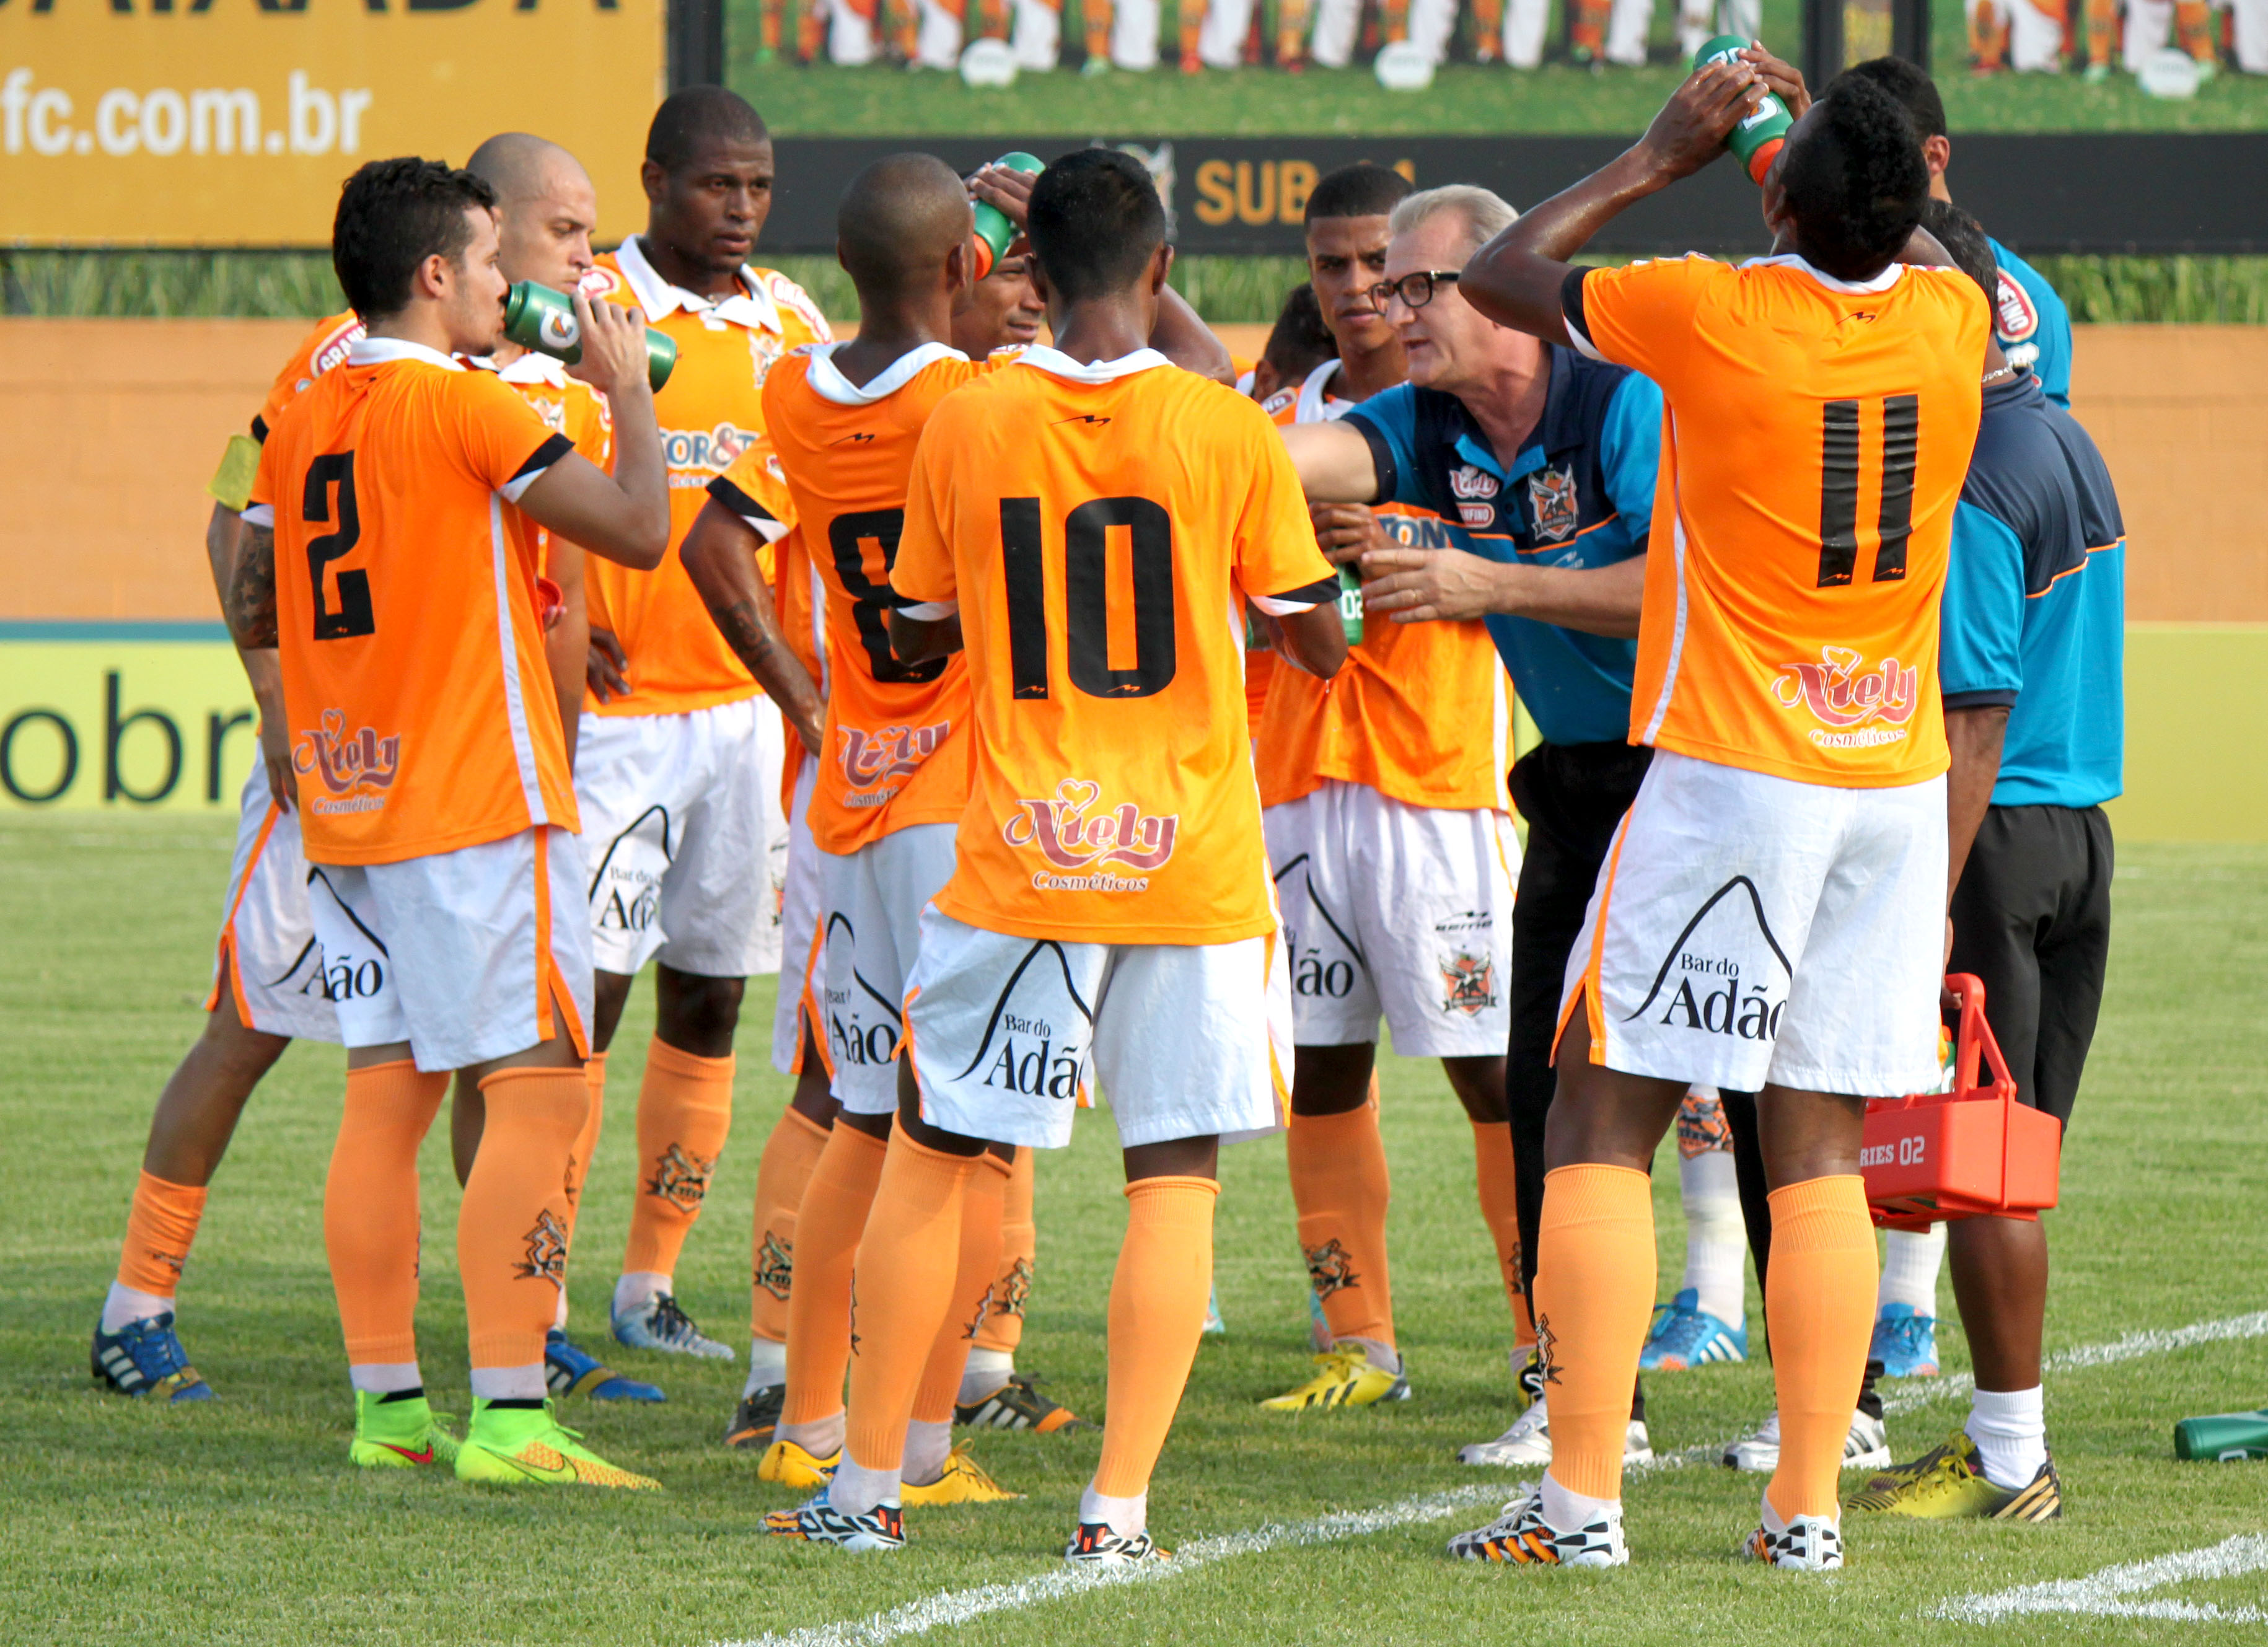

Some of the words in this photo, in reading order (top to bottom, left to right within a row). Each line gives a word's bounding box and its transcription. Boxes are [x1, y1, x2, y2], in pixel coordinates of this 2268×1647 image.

[0, 68, 370, 155] fc.com.br
[1816, 393, 1919, 588] 11
[302, 449, 375, 641] 2
[828, 507, 949, 683] 8
[999, 496, 1177, 699] 10
[1770, 645, 1917, 727] Niely
[0, 670, 253, 802] obr
[292, 708, 400, 794] Niely
[1809, 727, 1907, 749] Cosméticos
[1003, 778, 1179, 871] Niely
[1032, 870, 1149, 892] Cosméticos
[1681, 953, 1713, 973] Bar
[1716, 958, 1739, 977] do
[983, 1036, 1084, 1100] Adã
[1004, 1014, 1032, 1034] Bar
[1034, 1019, 1051, 1039] do
[1899, 1136, 1925, 1166] 02
